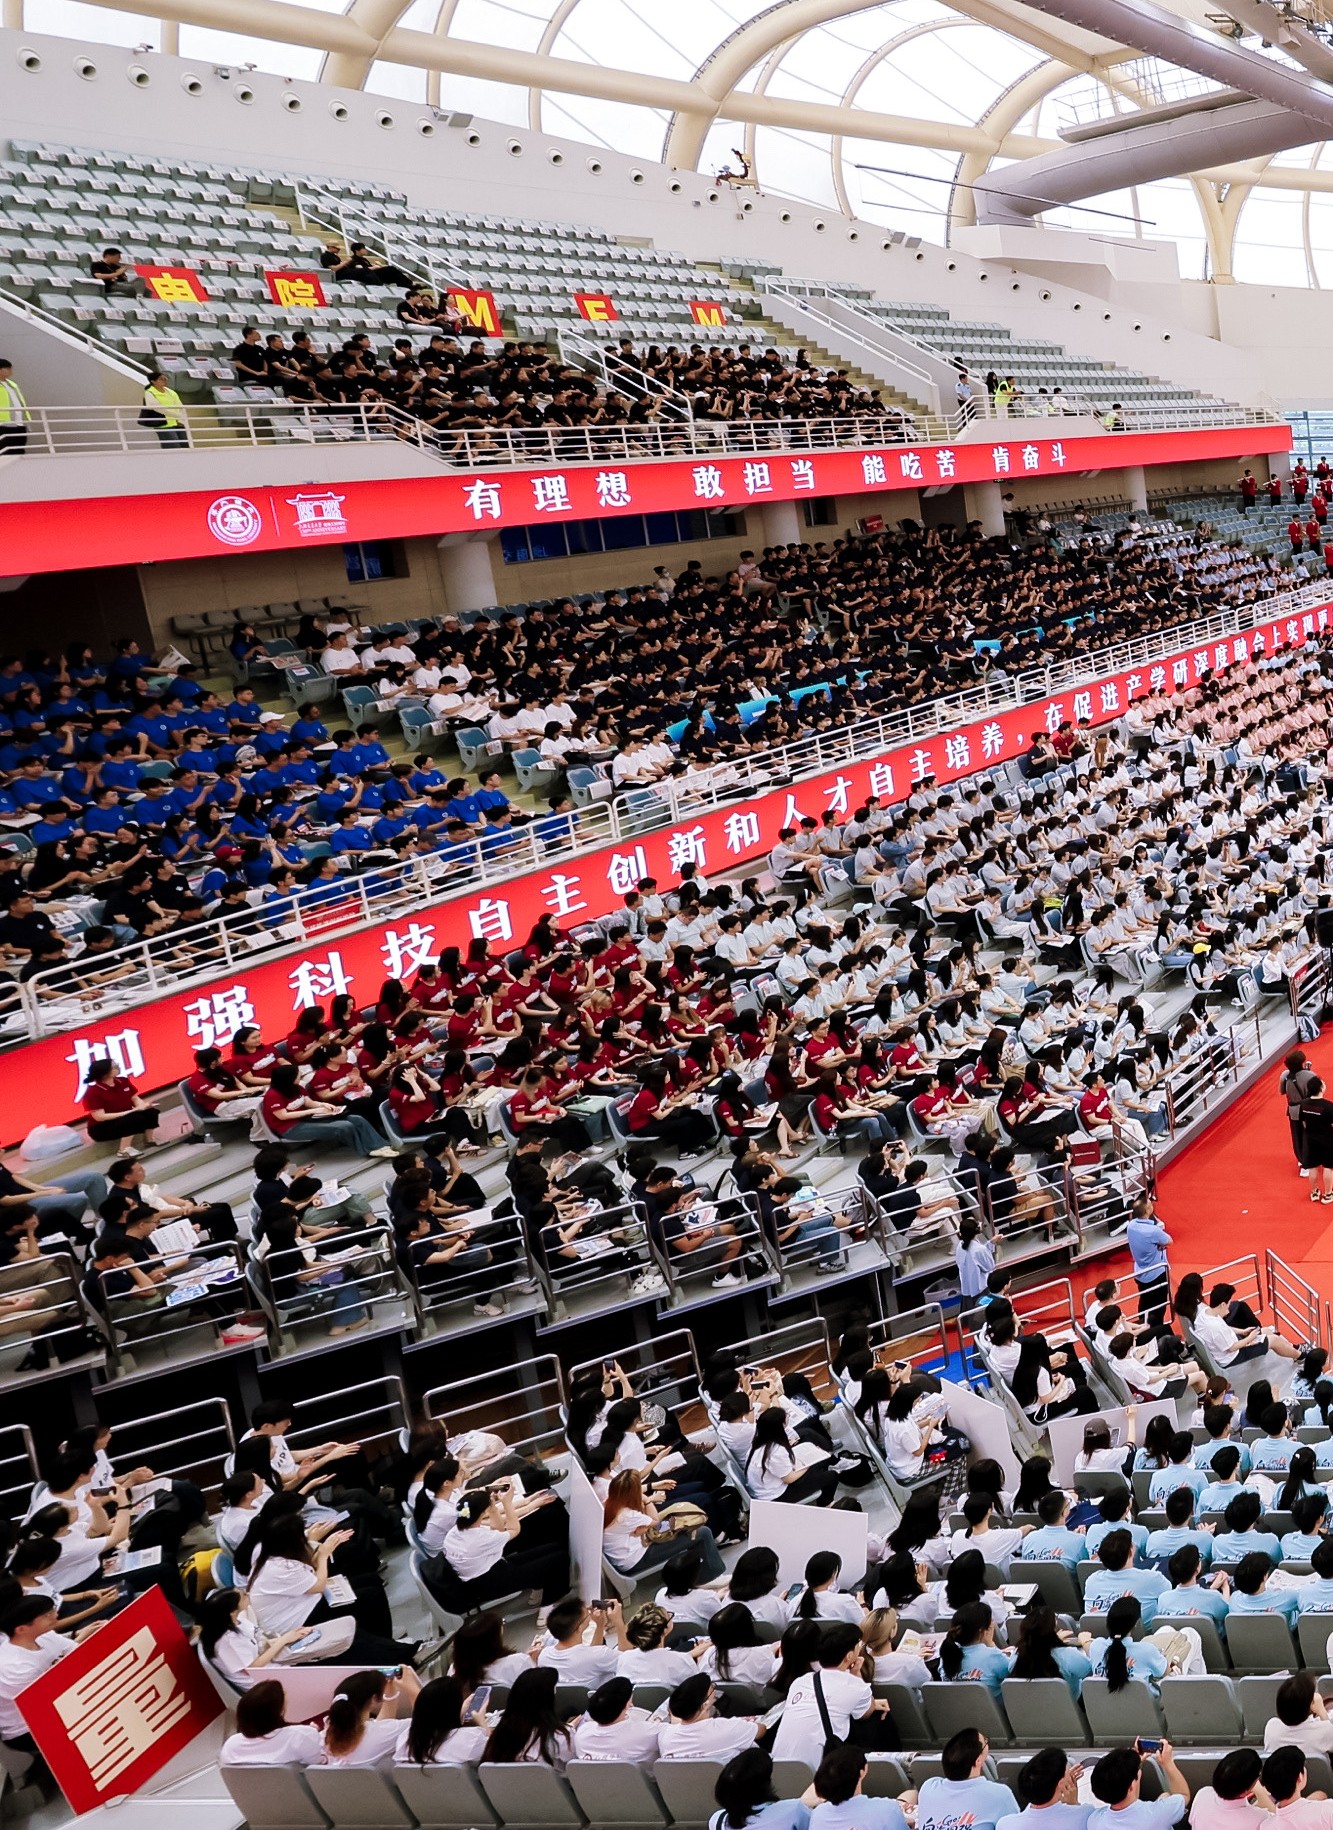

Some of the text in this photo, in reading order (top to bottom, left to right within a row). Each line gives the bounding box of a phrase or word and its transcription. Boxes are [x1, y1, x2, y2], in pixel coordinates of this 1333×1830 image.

[273, 278, 320, 308] 院
[453, 293, 496, 333] M
[695, 306, 723, 326] M
[462, 443, 1067, 520] 有理想 敢担当 能吃苦 肯奋斗
[53, 1625, 192, 1792] 量
